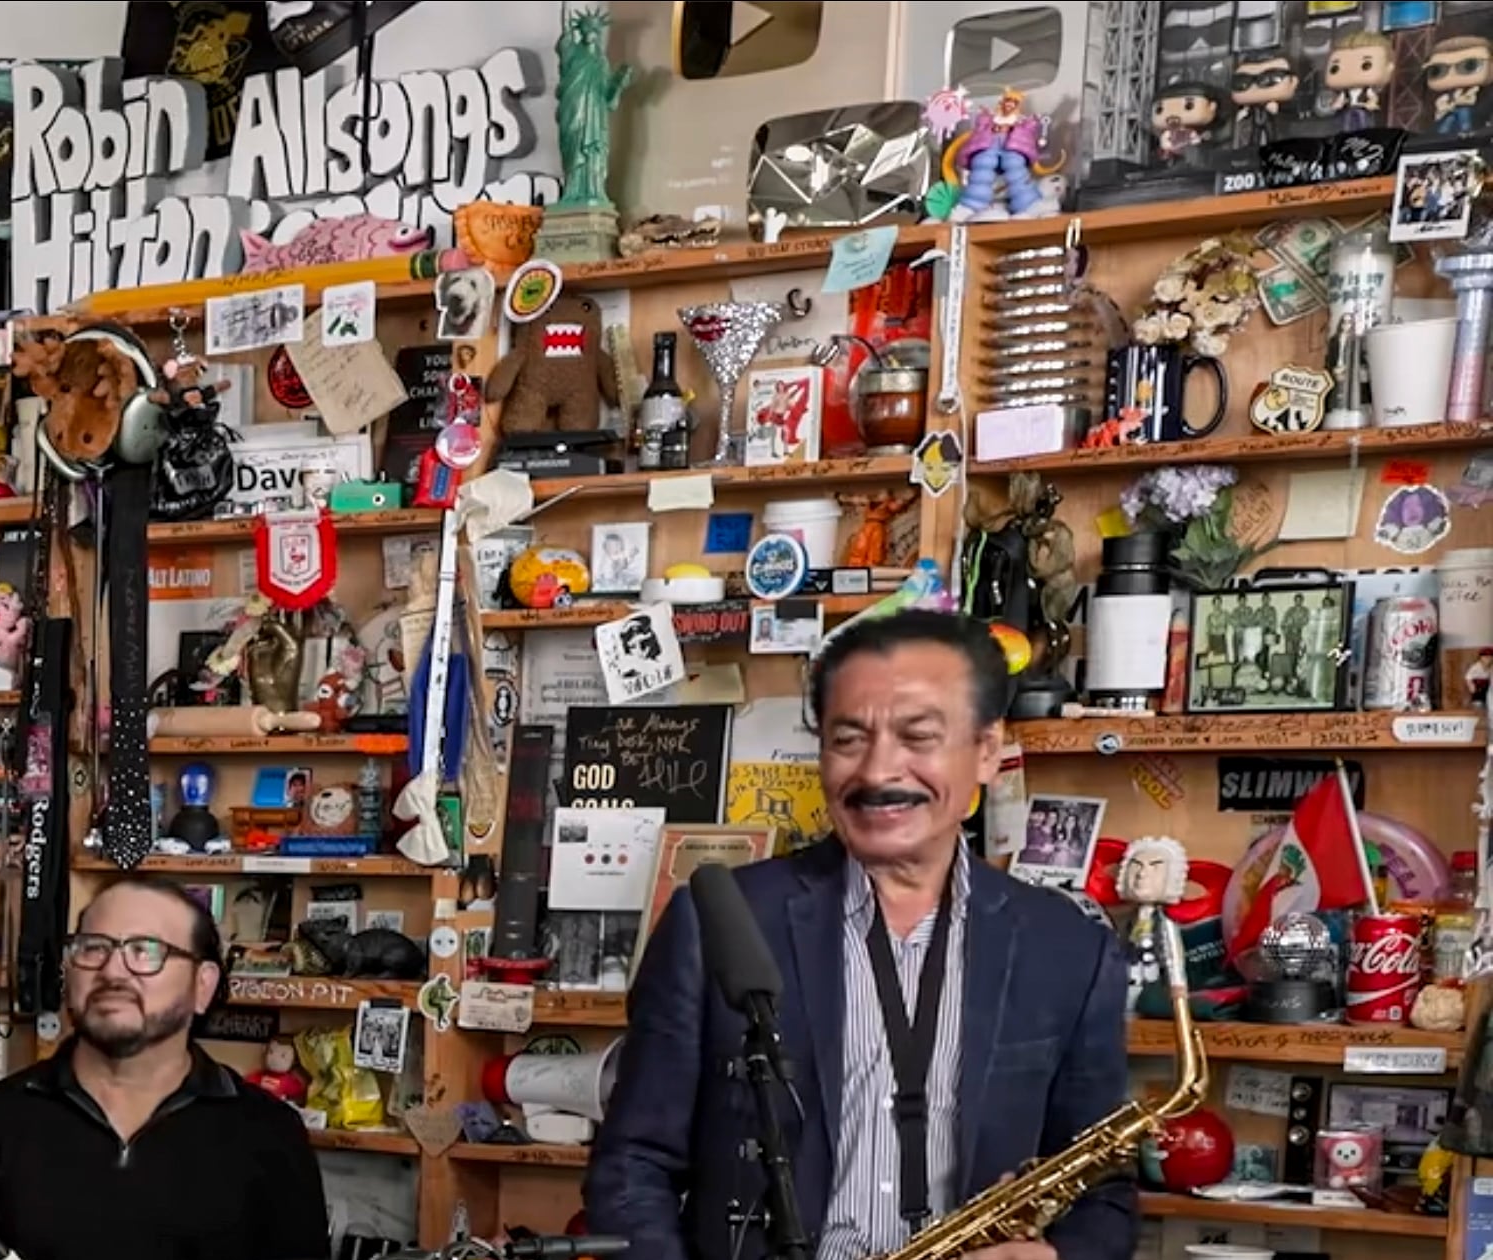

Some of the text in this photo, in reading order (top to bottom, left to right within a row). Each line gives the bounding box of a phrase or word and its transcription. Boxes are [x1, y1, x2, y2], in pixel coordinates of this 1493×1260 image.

[13, 48, 525, 208] Robin Allsongs
[14, 178, 232, 312] Hilton
[171, 569, 210, 587] LATINO
[573, 765, 615, 790] GOD
[27, 800, 50, 899] Rodgers
[229, 979, 354, 1004] PIGEON PIT
